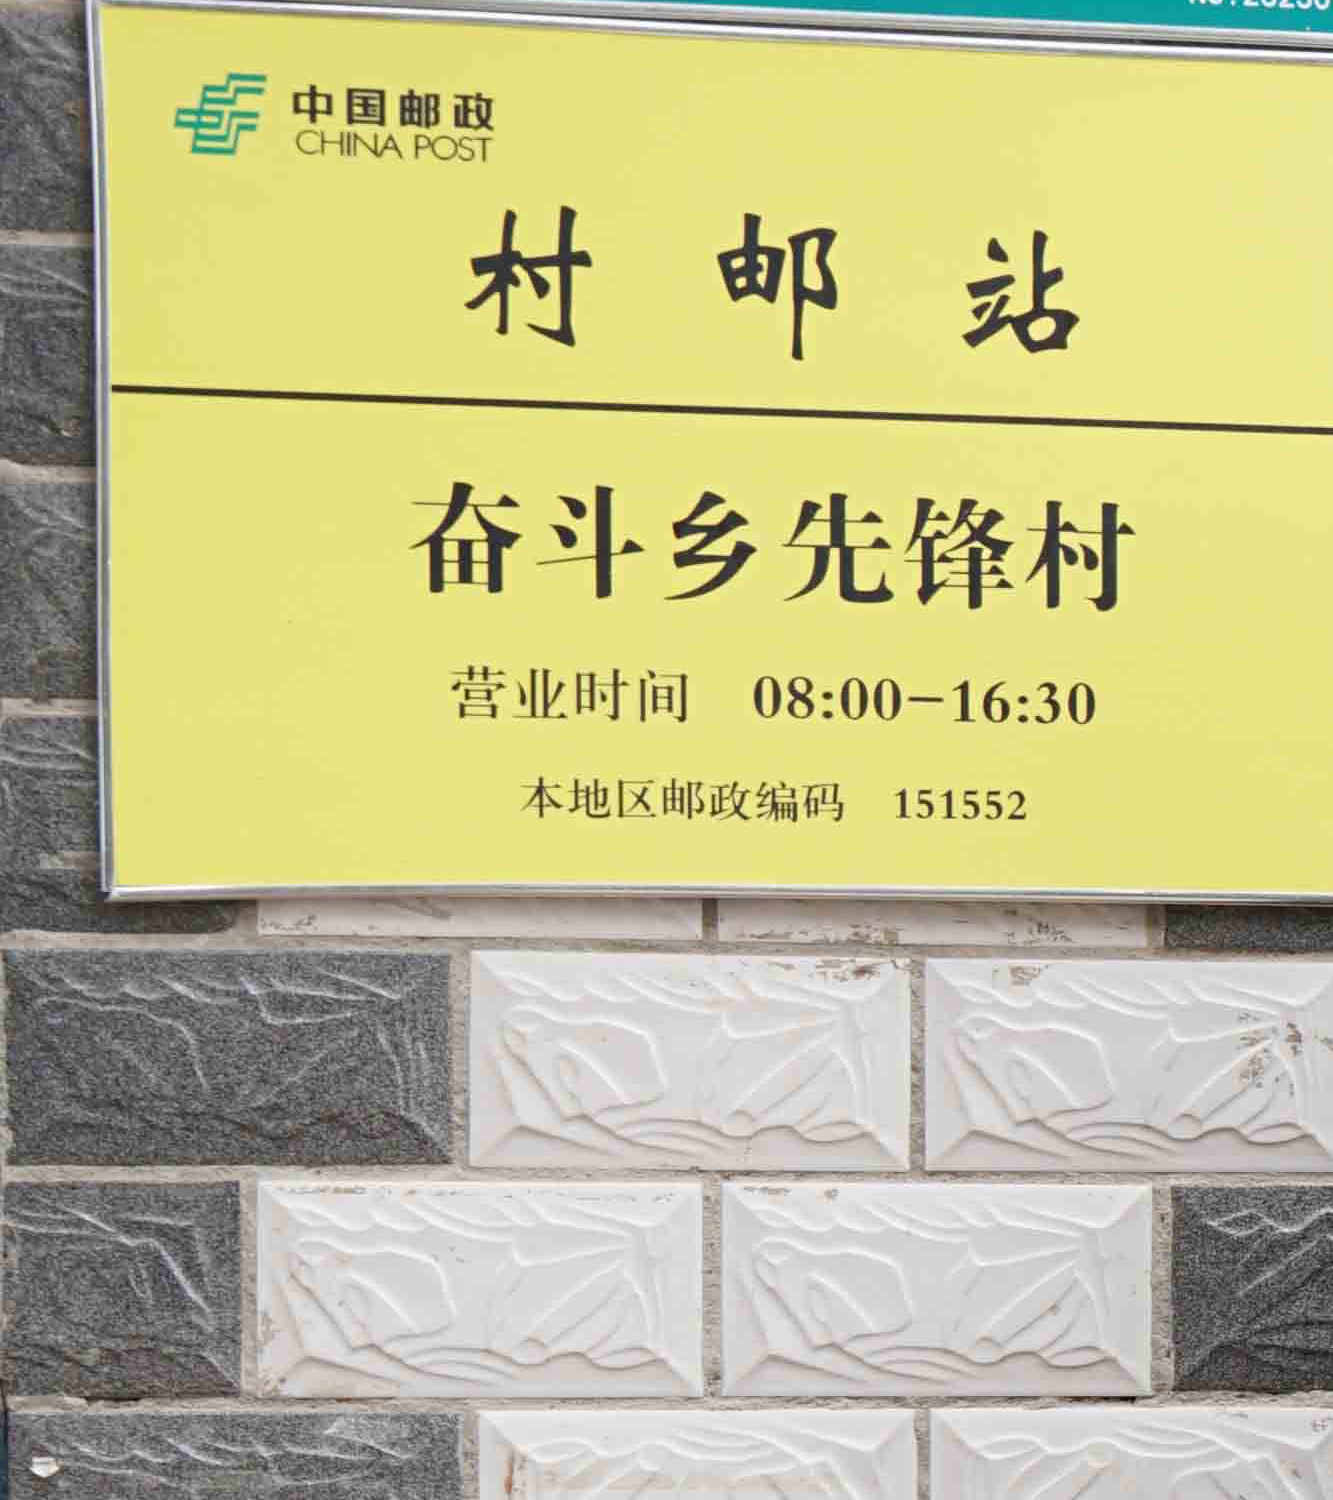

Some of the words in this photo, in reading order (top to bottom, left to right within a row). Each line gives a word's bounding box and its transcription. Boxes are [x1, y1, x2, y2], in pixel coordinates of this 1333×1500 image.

[292, 84, 494, 132] 中国邮政
[295, 130, 403, 159] CHINA
[414, 134, 494, 162] POST
[409, 481, 1136, 613] 奋斗乡先锋村
[450, 665, 689, 723] 营业时间
[752, 675, 1097, 725] 08:00-16:30
[521, 776, 845, 823] 本地区邮政编码
[893, 788, 1028, 821] 151552
